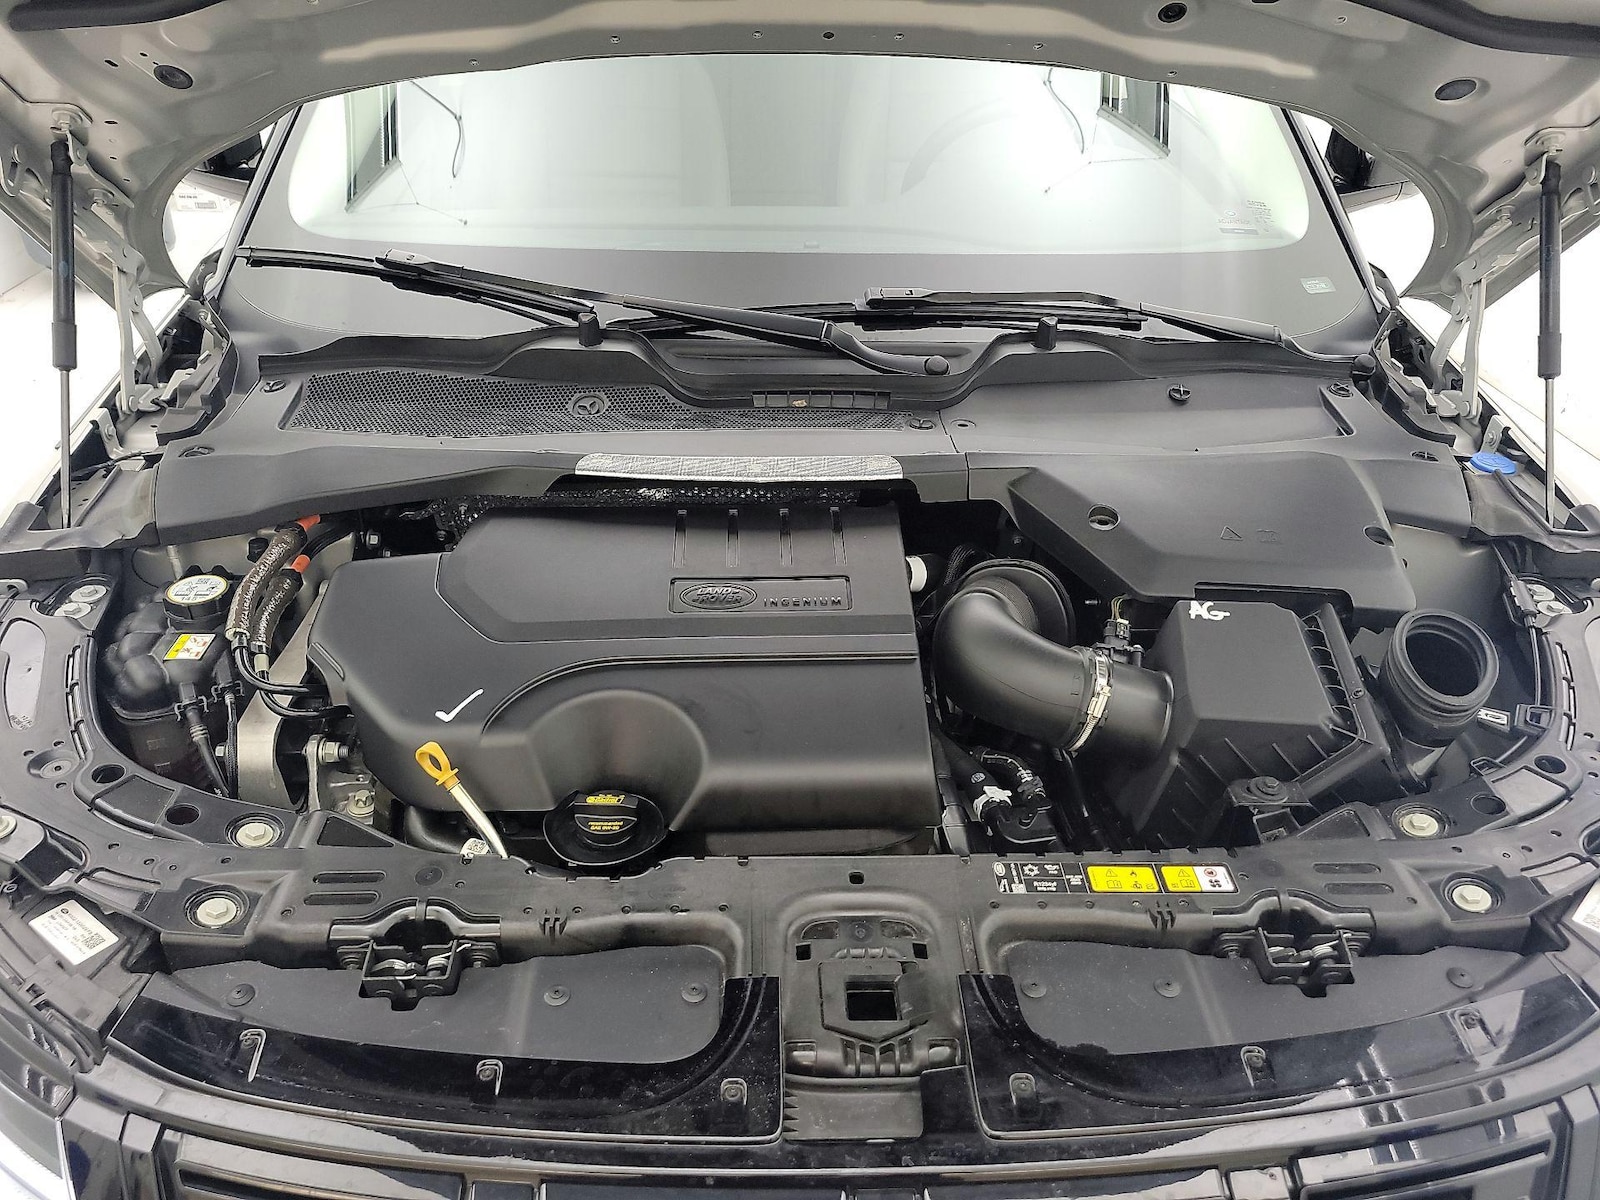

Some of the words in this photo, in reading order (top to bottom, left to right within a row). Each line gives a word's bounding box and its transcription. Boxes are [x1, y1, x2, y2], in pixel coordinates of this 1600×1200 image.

[697, 587, 734, 595] LAND
[697, 594, 743, 604] ROVER
[763, 597, 842, 608] INGENIUM
